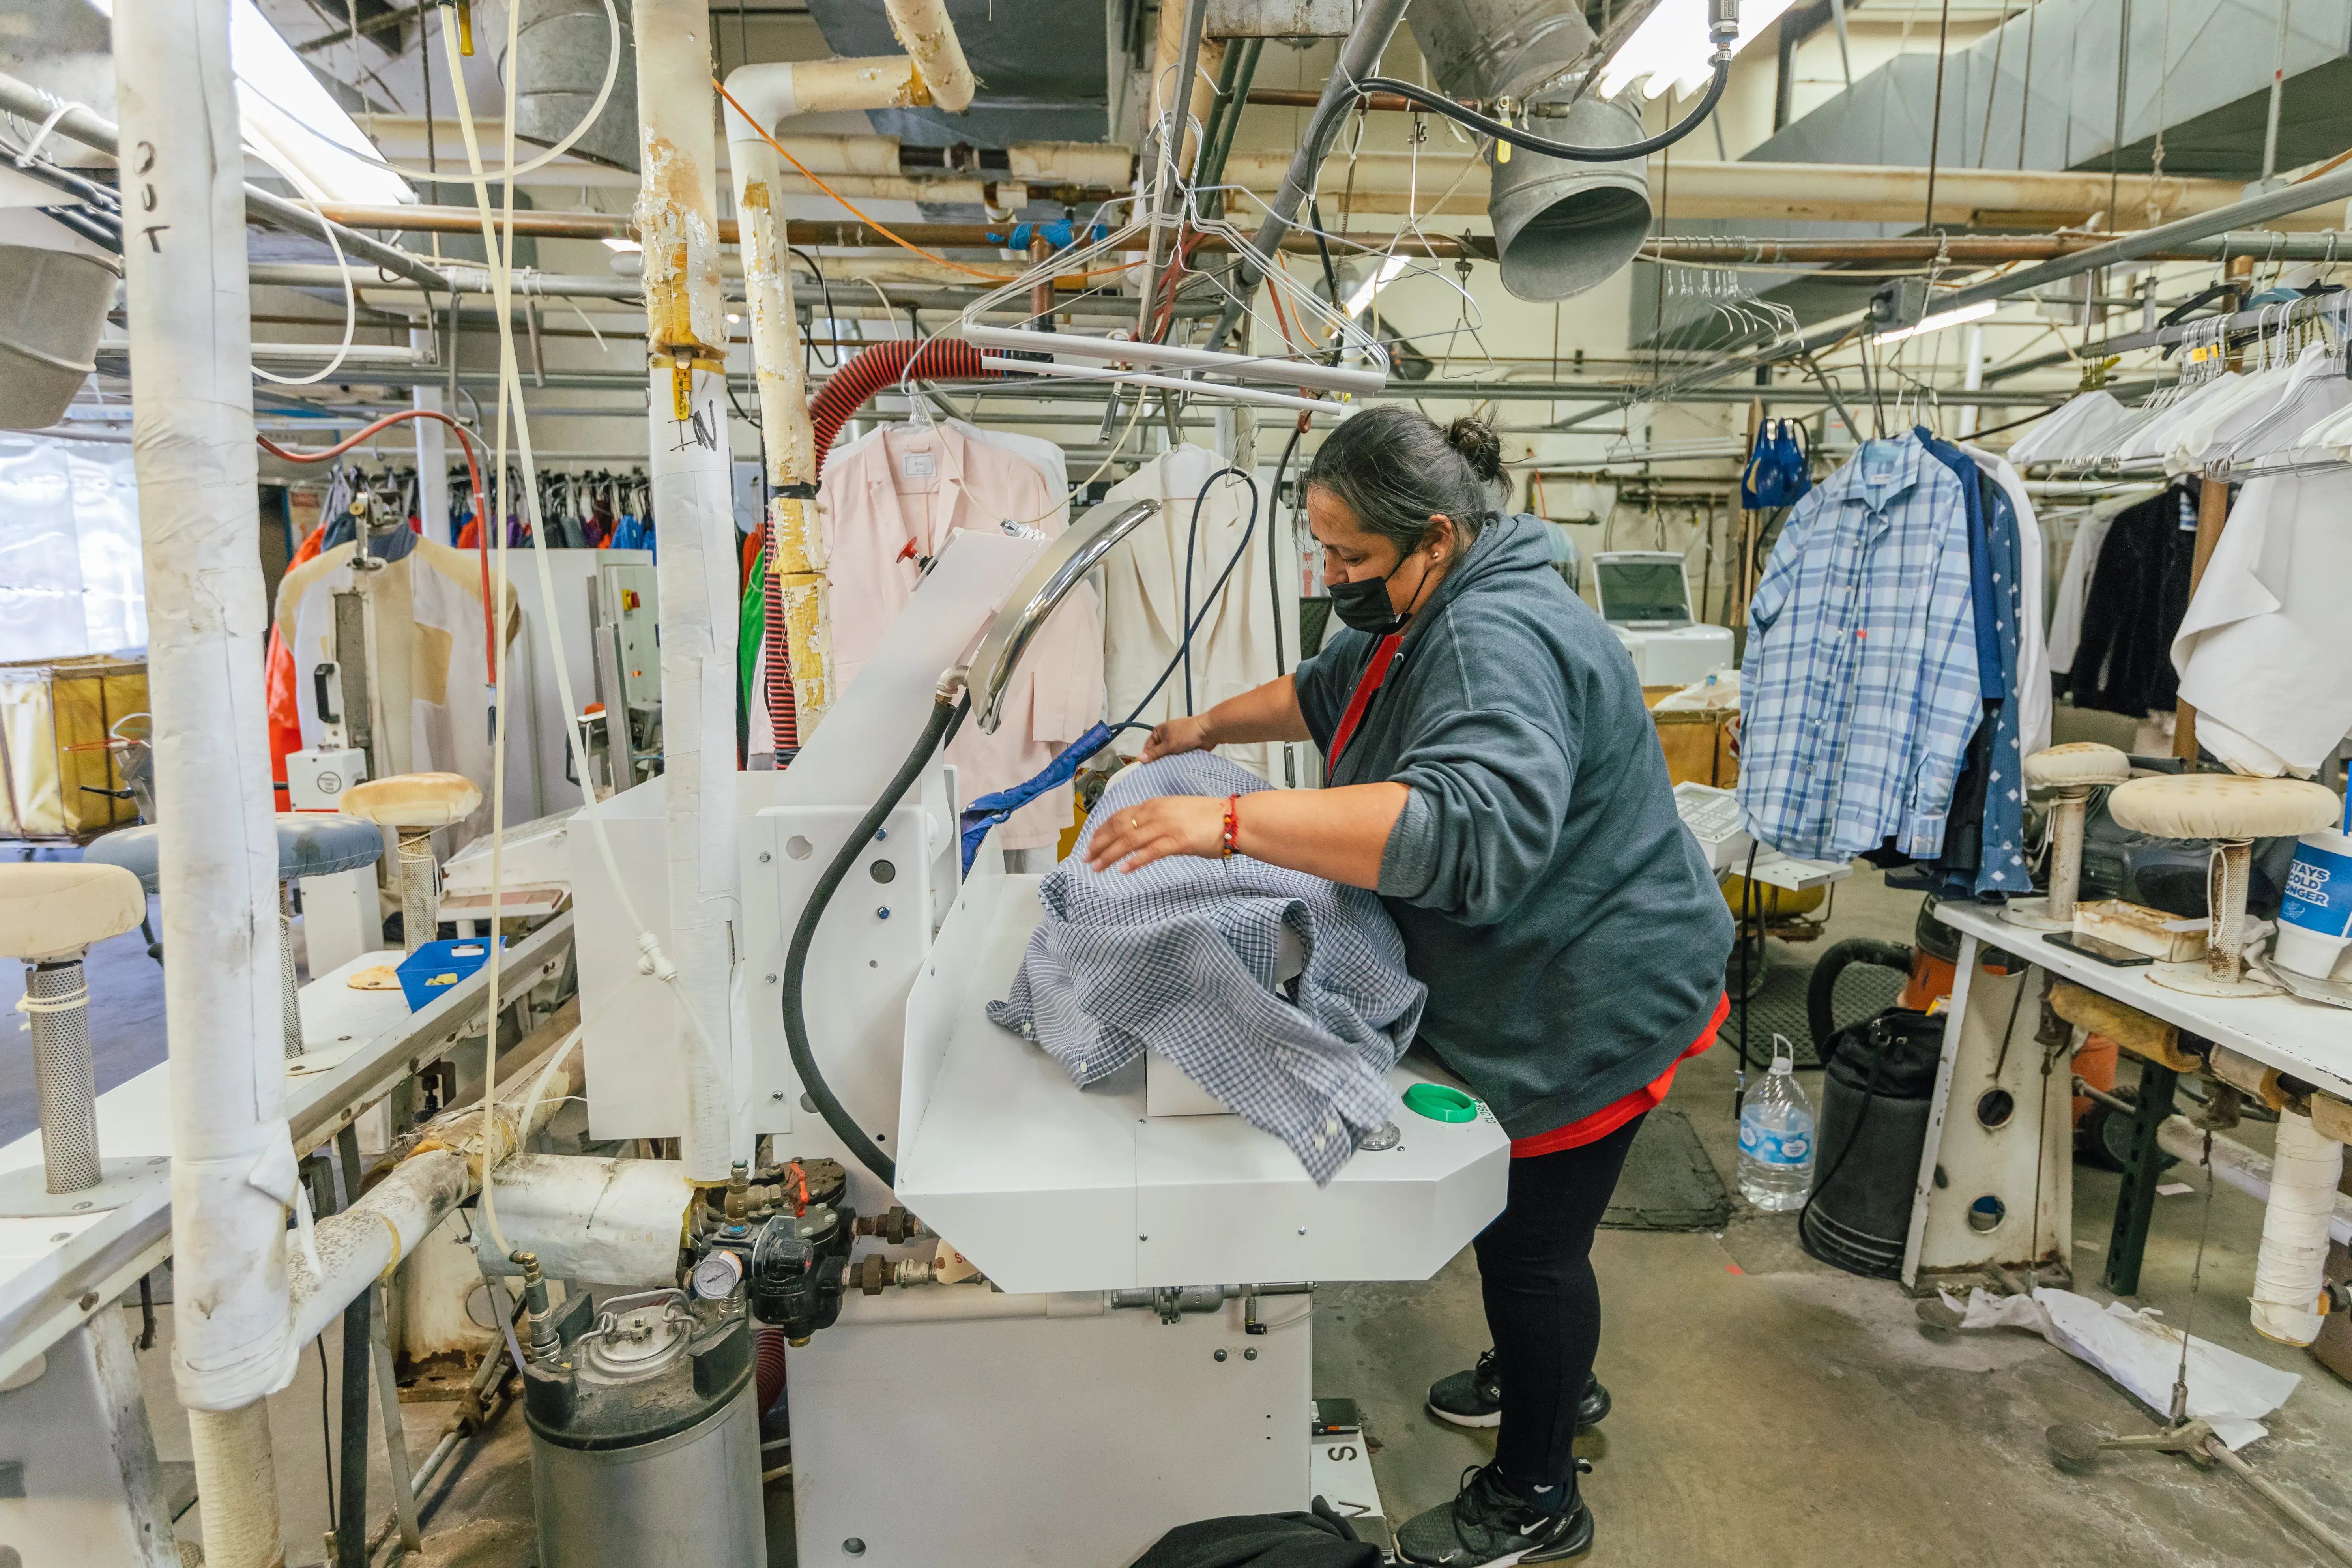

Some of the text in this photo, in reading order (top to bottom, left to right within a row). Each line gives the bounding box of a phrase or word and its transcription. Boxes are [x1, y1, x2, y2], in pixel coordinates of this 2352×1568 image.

[133, 141, 171, 254] OUT
[668, 399, 717, 452] IN
[2285, 883, 2326, 904] ONGER
[1476, 1104, 1496, 1124] CLOSE
[954, 1252, 966, 1263] S
[1327, 1445, 1357, 1461] S
